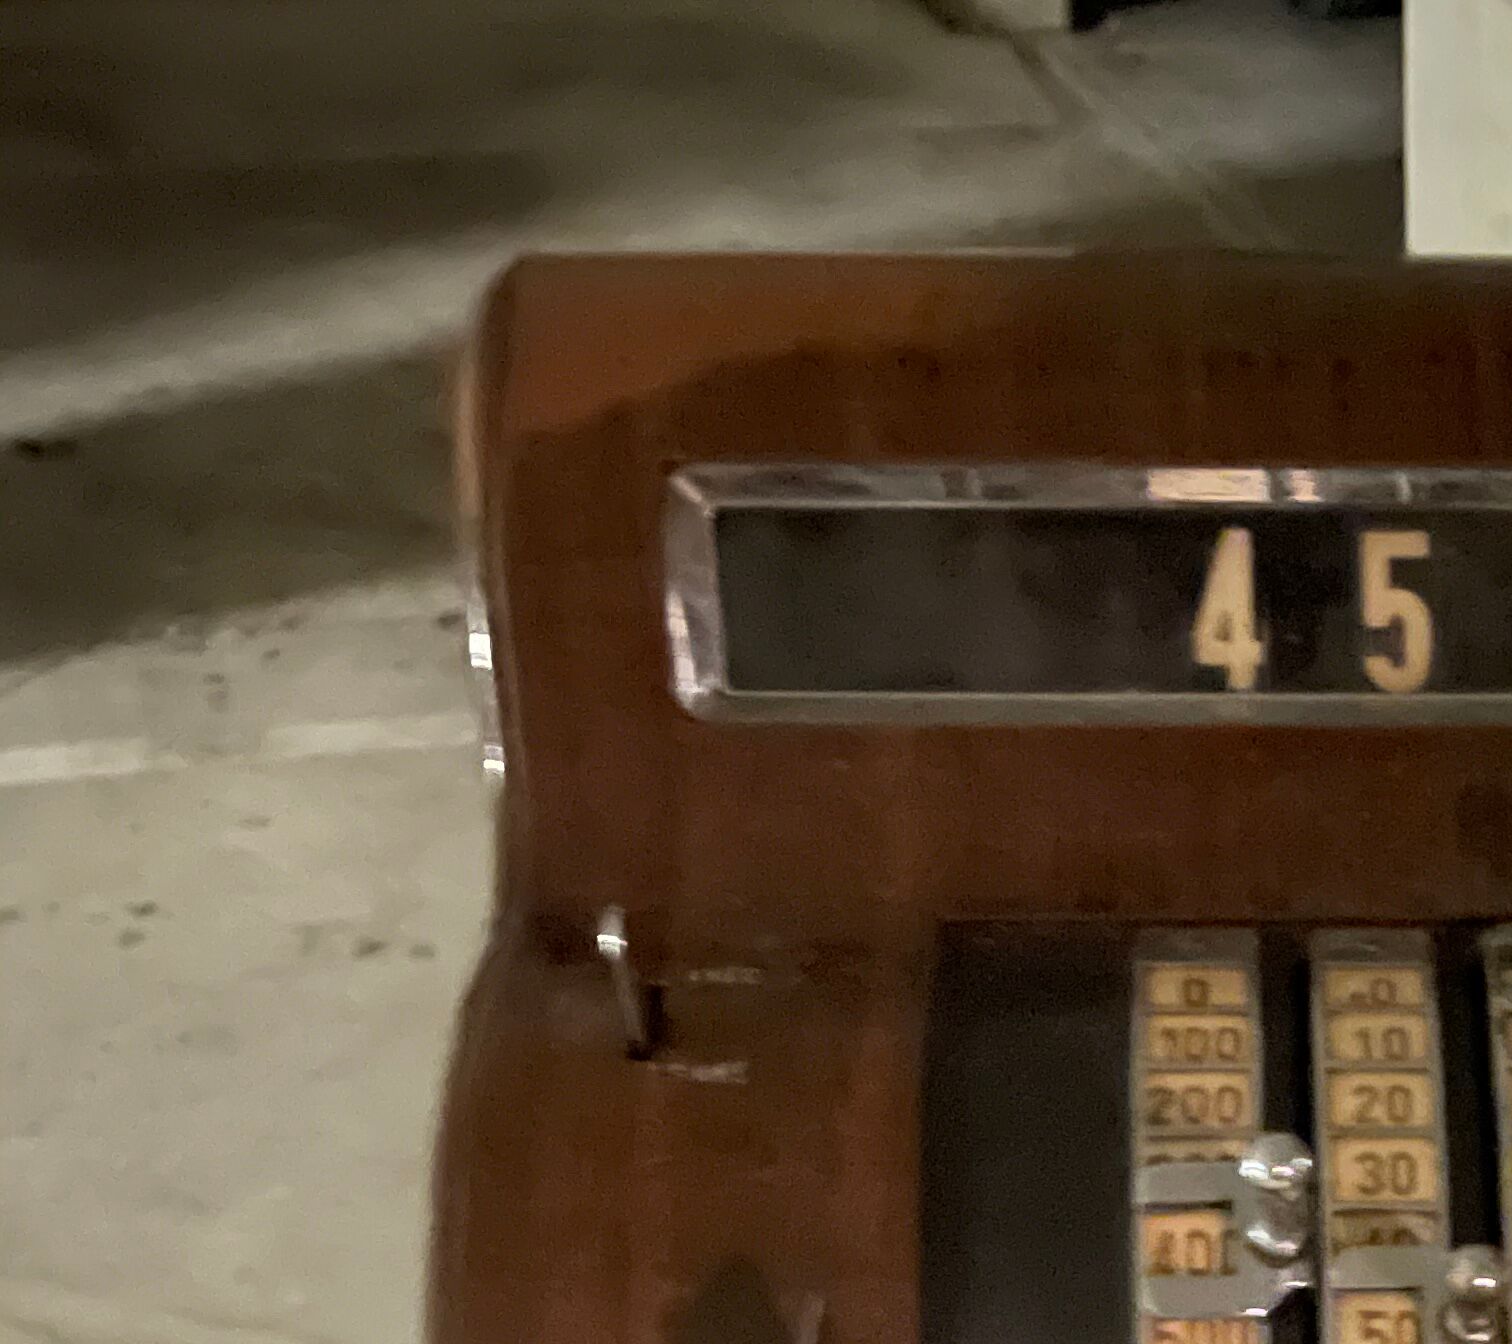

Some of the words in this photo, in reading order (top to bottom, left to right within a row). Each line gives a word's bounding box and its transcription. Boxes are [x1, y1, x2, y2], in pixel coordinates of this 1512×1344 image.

[1159, 1027, 1243, 1061] 100
[1355, 1026, 1409, 1060] 10
[1146, 1086, 1243, 1126] 200
[1351, 1085, 1414, 1124] 20
[1354, 1152, 1418, 1195] 30
